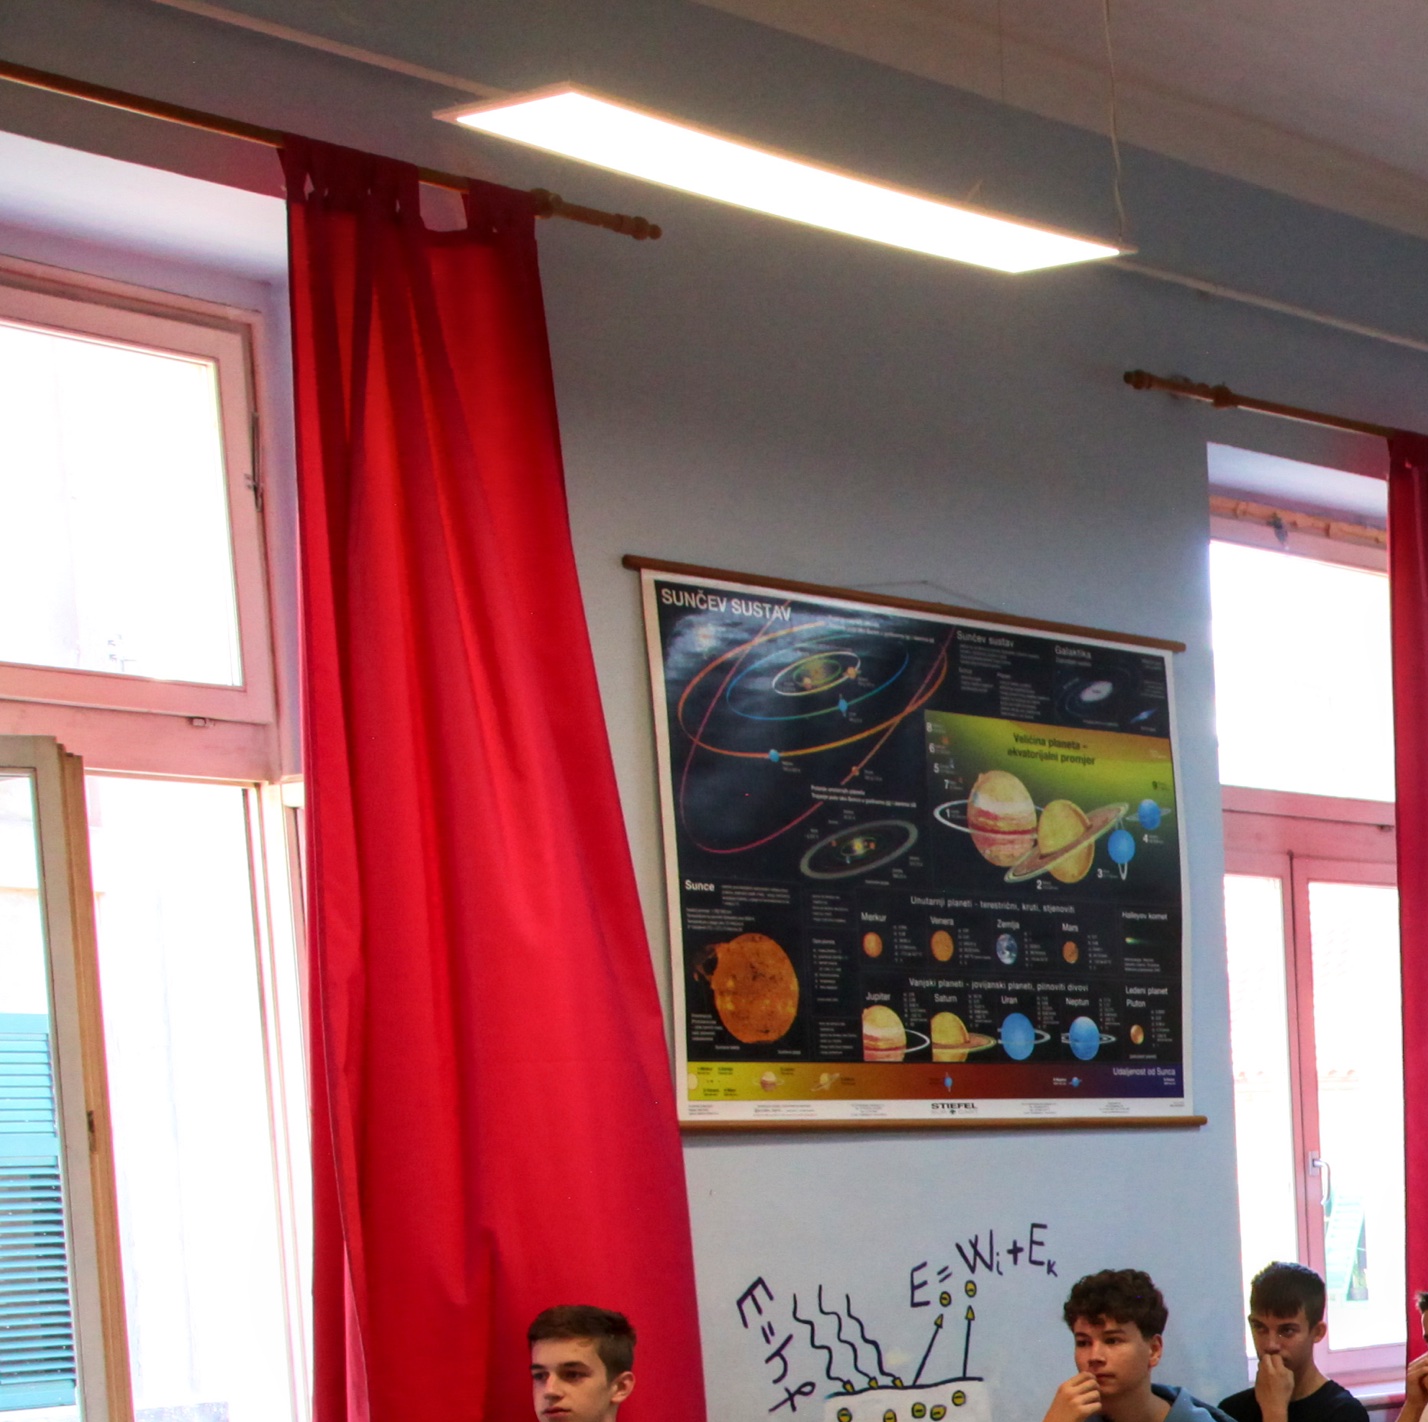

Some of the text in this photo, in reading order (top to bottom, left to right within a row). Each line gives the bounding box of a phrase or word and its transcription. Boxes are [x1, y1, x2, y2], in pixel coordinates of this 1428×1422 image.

[661, 588, 792, 621] SUNČEV SUSTAV
[1054, 645, 1092, 659] Galaktika
[1048, 738, 1081, 750] planeta
[1060, 754, 1095, 766] promjer
[684, 879, 715, 893] Sunce
[947, 898, 973, 909] planeti
[861, 911, 887, 922] Merkur
[929, 915, 954, 926] Venera
[996, 919, 1020, 930] Zemlja
[1061, 922, 1079, 933] Mars
[909, 977, 936, 988] Vanjski
[938, 979, 964, 988] planeti
[1067, 983, 1089, 992] divovi
[865, 991, 892, 1002] Jupiter
[1147, 987, 1168, 996] planet
[934, 993, 957, 1003] Saturn
[1001, 995, 1018, 1004] Uran
[1065, 997, 1089, 1007] Neptun
[1126, 998, 1146, 1008] Pluton
[1147, 1067, 1156, 1075] od
